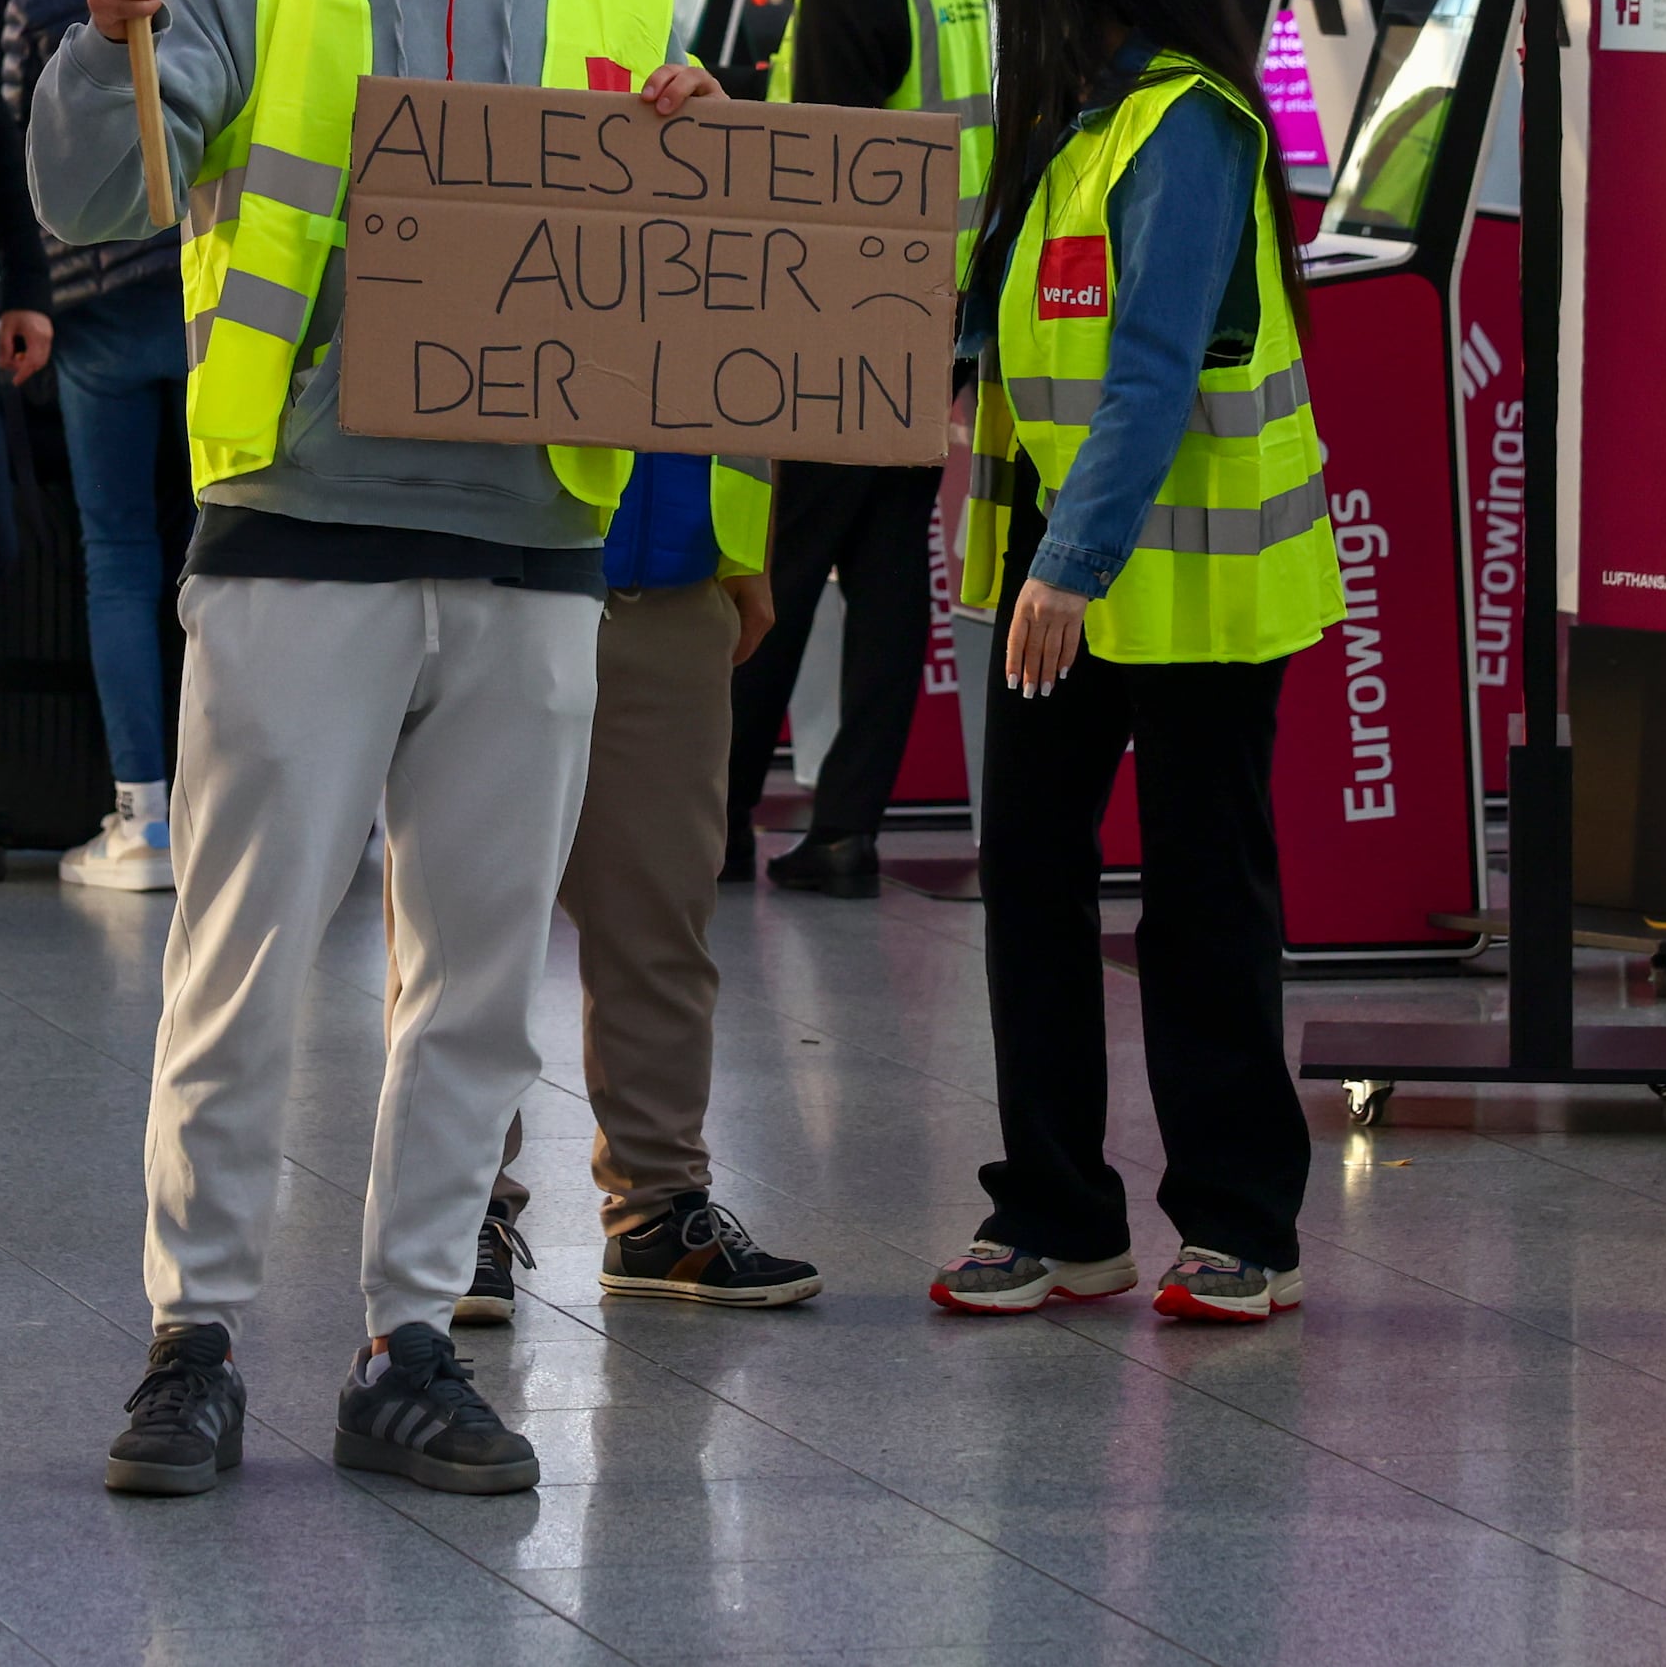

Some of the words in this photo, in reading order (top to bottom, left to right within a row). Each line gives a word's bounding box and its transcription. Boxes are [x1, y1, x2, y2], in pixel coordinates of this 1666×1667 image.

[357, 95, 633, 196] ALLES
[652, 116, 954, 216] STEIGT
[496, 217, 821, 323] AUßER
[1043, 285, 1102, 307] ver.di
[413, 339, 580, 421] DER
[650, 339, 913, 434] LOHN
[1476, 400, 1524, 687] Eurowings
[1332, 487, 1396, 823] Eurowings
